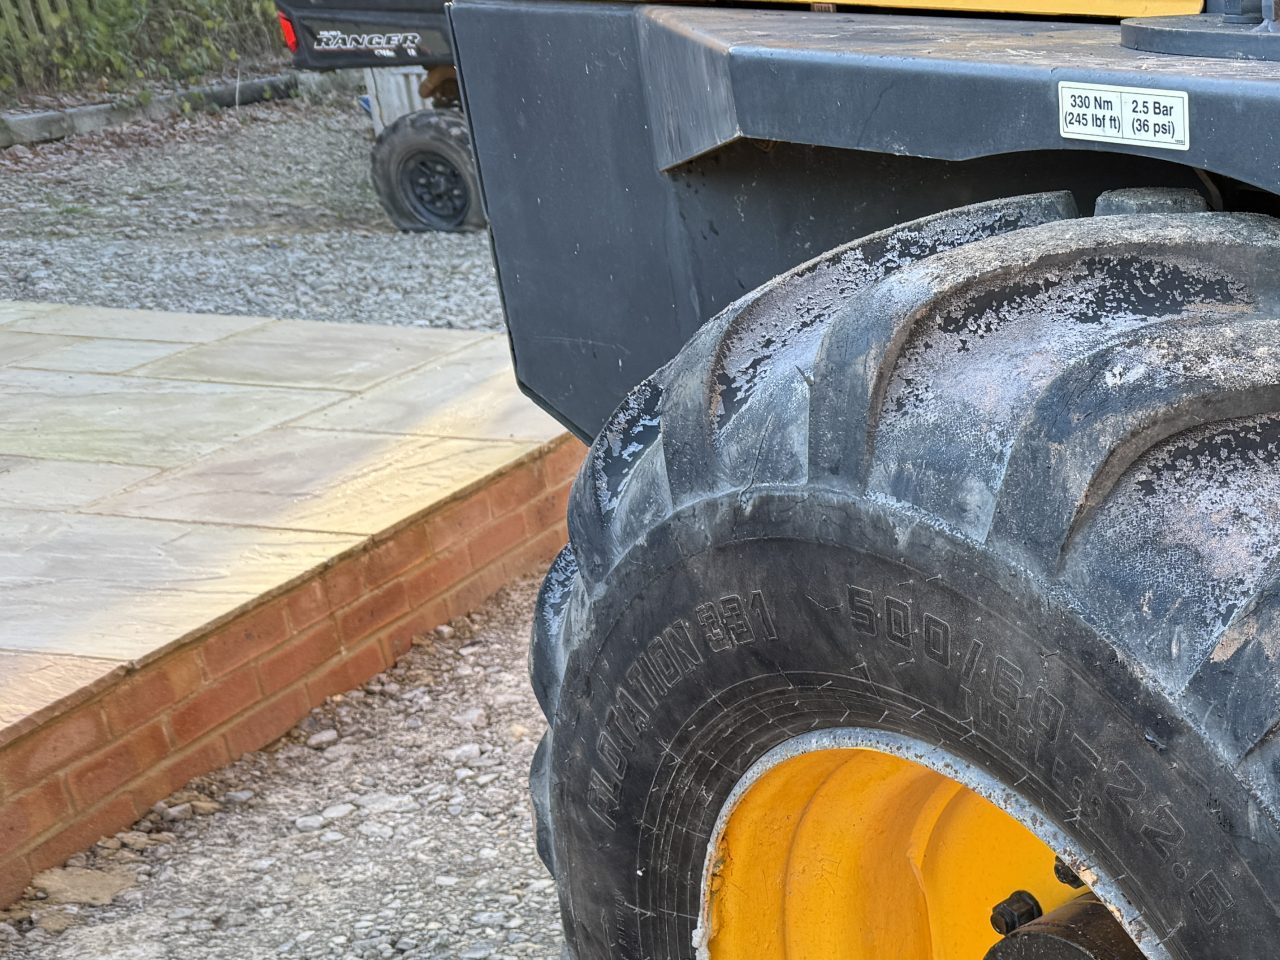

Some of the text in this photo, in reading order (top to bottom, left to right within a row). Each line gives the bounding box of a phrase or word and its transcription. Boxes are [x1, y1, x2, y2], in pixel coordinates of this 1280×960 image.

[314, 33, 421, 50] RANGER
[1071, 95, 1113, 111] 330 Nm
[1132, 100, 1173, 116] 2.5 Bar
[1065, 111, 1121, 133] (245 lbf ft)
[1132, 118, 1175, 139] (36 psi)
[586, 590, 777, 831] FLOTATION 331
